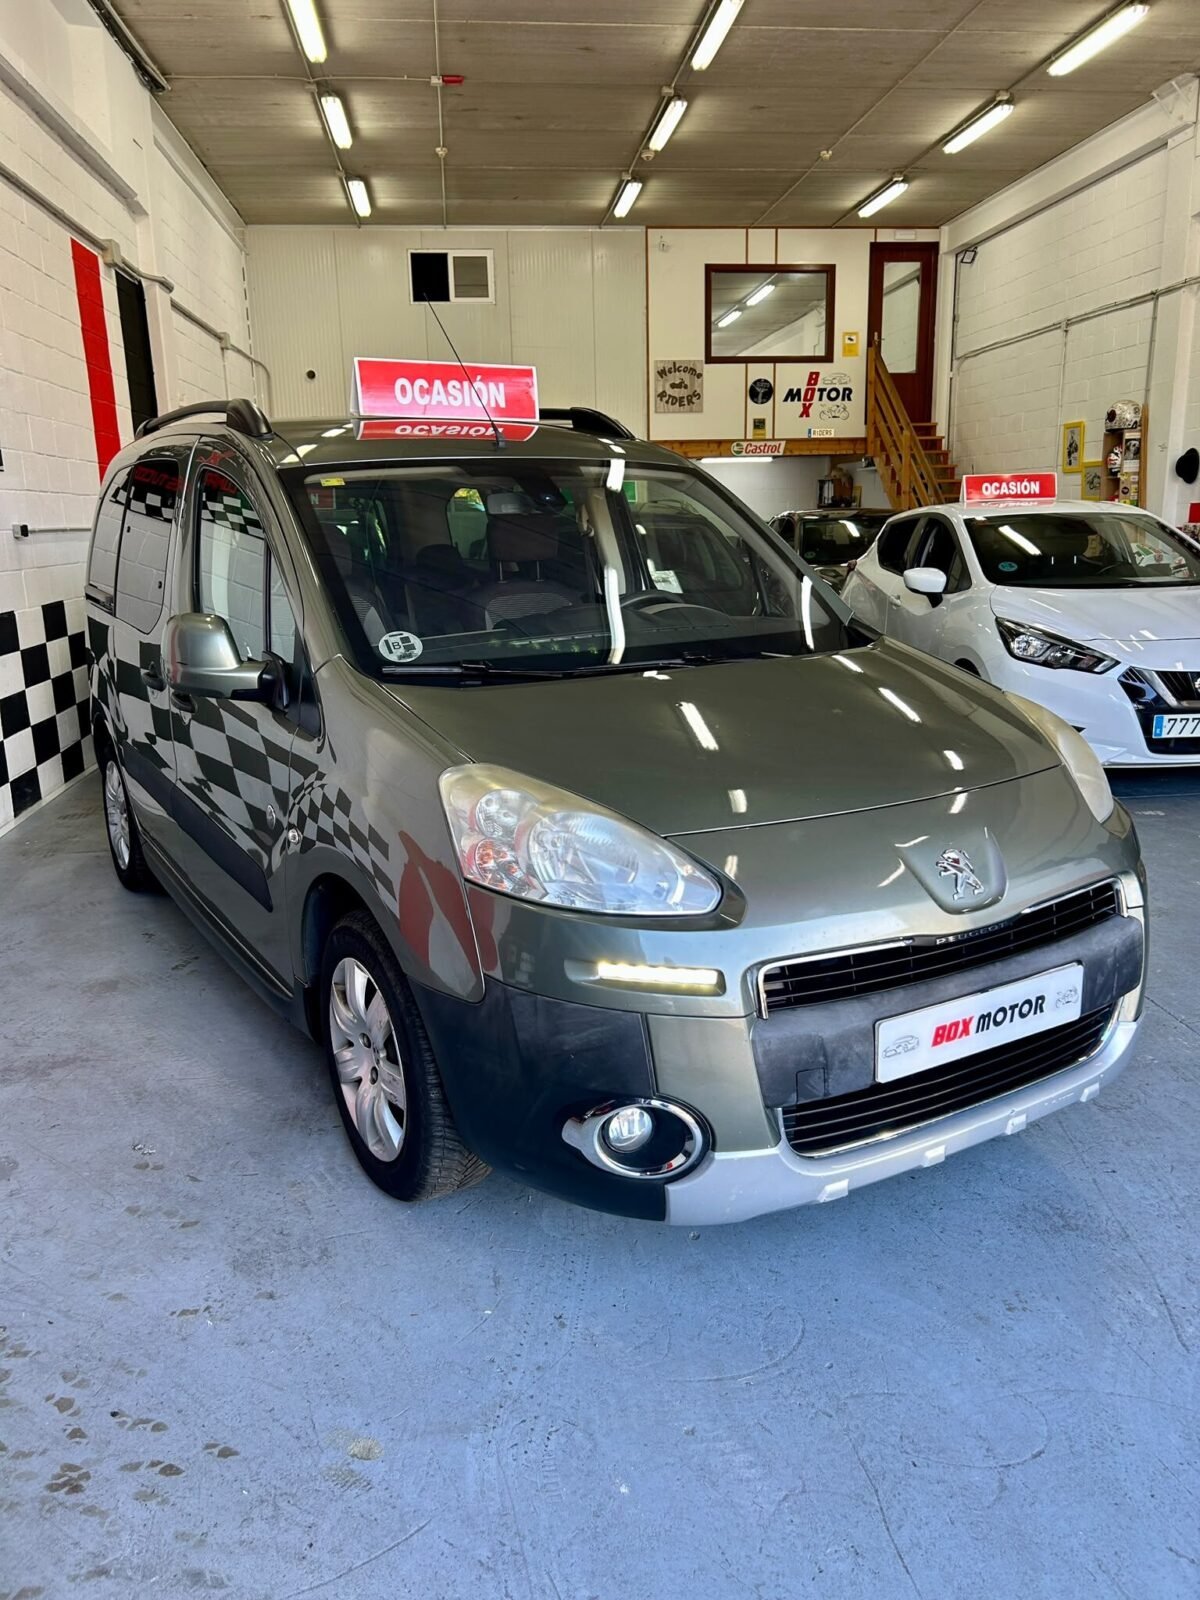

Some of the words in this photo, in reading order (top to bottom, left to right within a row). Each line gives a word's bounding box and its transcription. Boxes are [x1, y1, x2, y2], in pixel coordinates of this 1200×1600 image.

[656, 361, 703, 379] Welcome
[394, 375, 507, 409] OCASIÓN
[657, 390, 701, 407] RIDERS
[798, 371, 820, 418] BOX
[745, 443, 781, 454] Castrol
[982, 479, 1040, 496] OCASIÓN
[936, 922, 1008, 944] PEUGEOT
[932, 1016, 974, 1047] BOX
[976, 995, 1045, 1033] MOTOR
